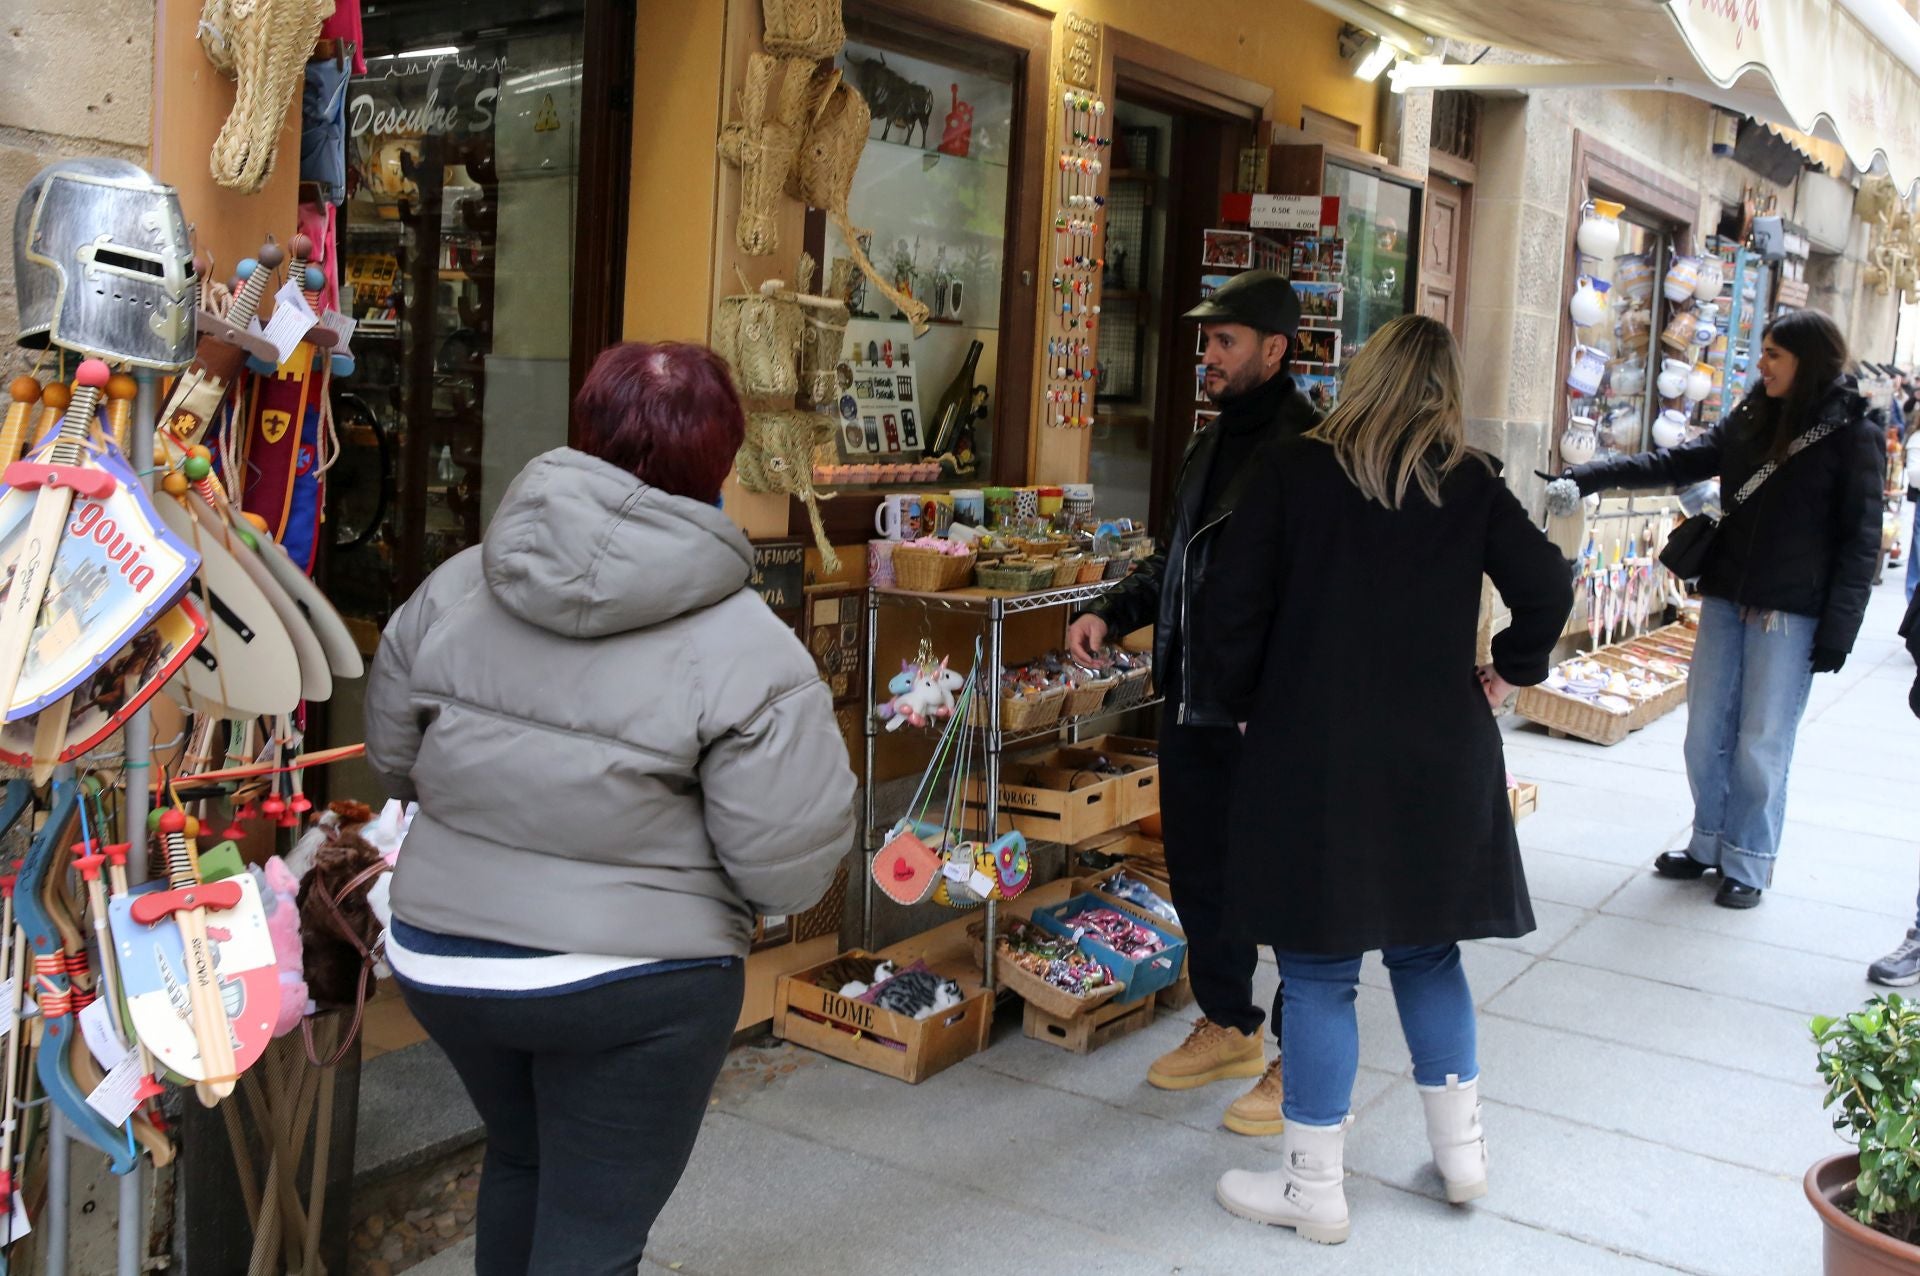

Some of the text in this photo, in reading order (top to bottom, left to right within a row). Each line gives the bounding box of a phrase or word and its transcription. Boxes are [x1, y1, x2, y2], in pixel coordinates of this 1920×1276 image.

[350, 87, 498, 138] Descubre S
[71, 498, 155, 593] govia
[755, 548, 803, 567] AFIADOS
[760, 588, 785, 605] VIA
[998, 789, 1038, 806] TORAGE
[822, 991, 875, 1030] HOME
